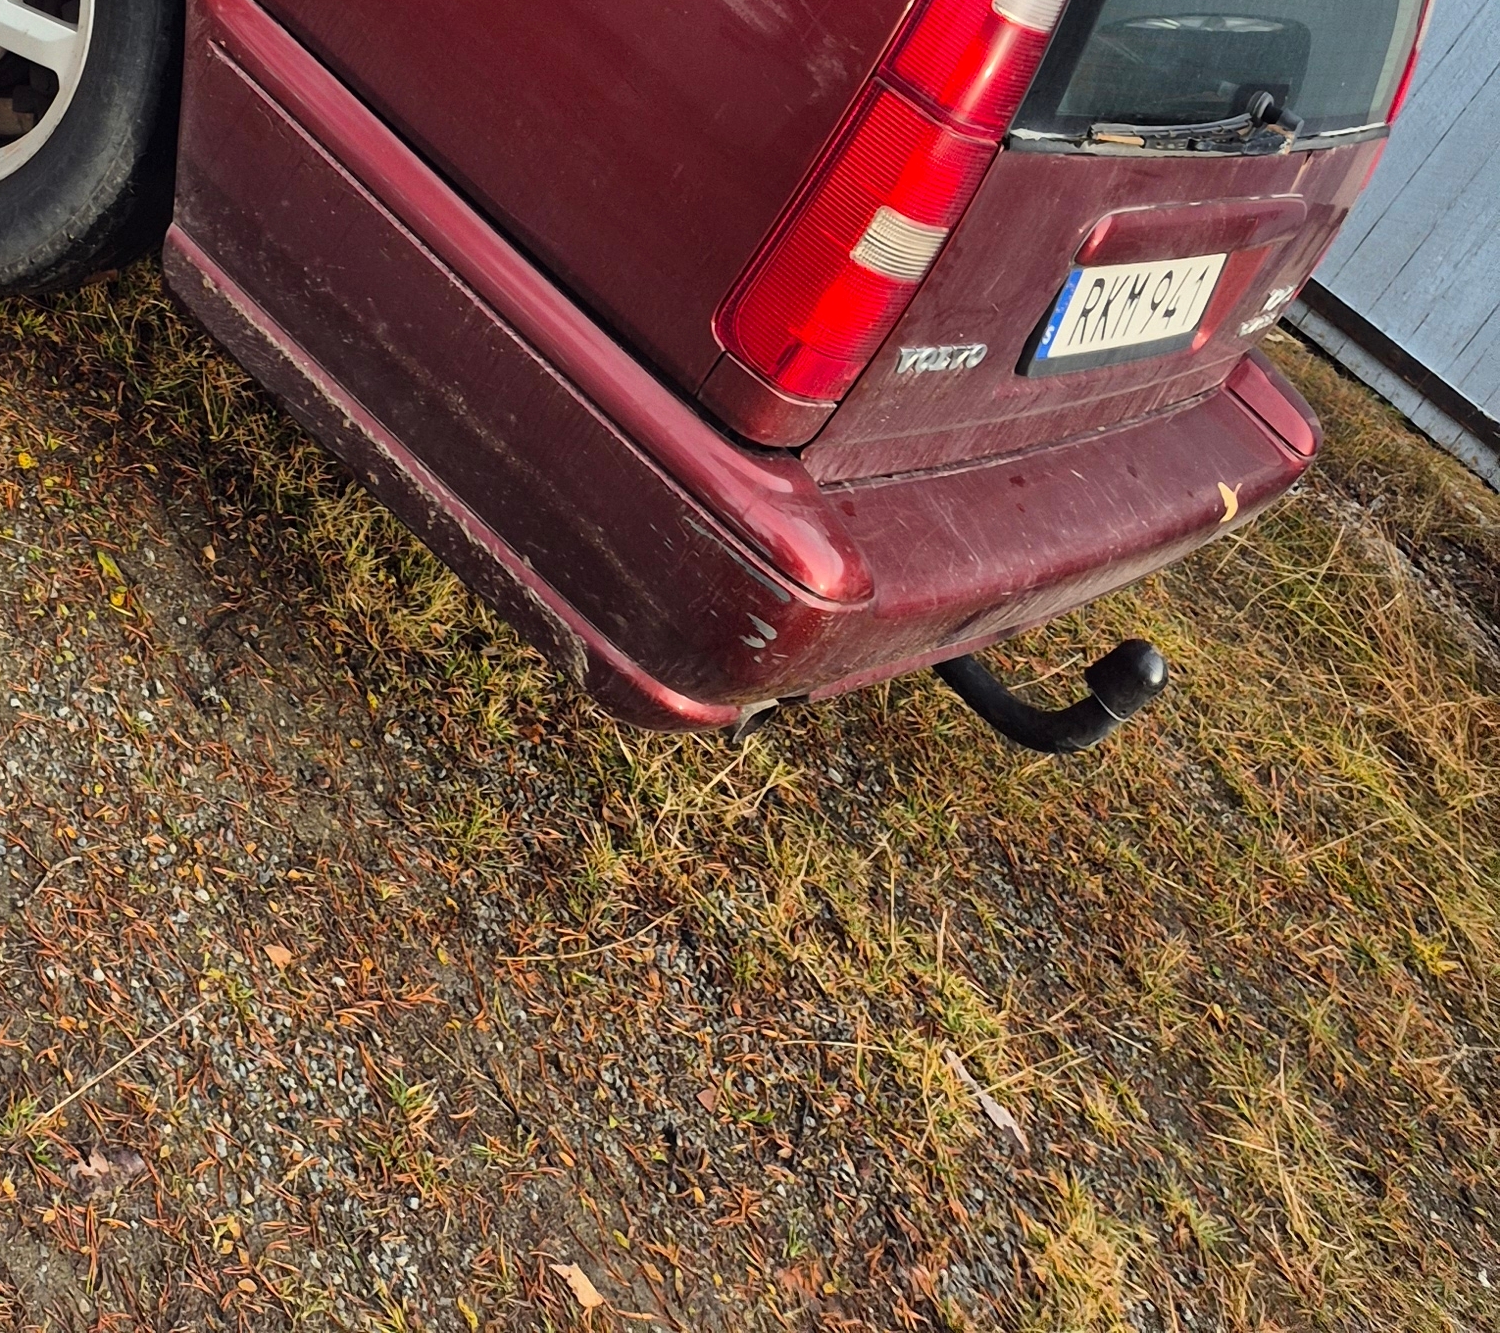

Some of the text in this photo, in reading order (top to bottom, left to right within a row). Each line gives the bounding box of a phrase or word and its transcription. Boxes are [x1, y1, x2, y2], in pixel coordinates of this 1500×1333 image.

[1067, 265, 1210, 346] RKM 941
[896, 343, 988, 374] VOLVO
